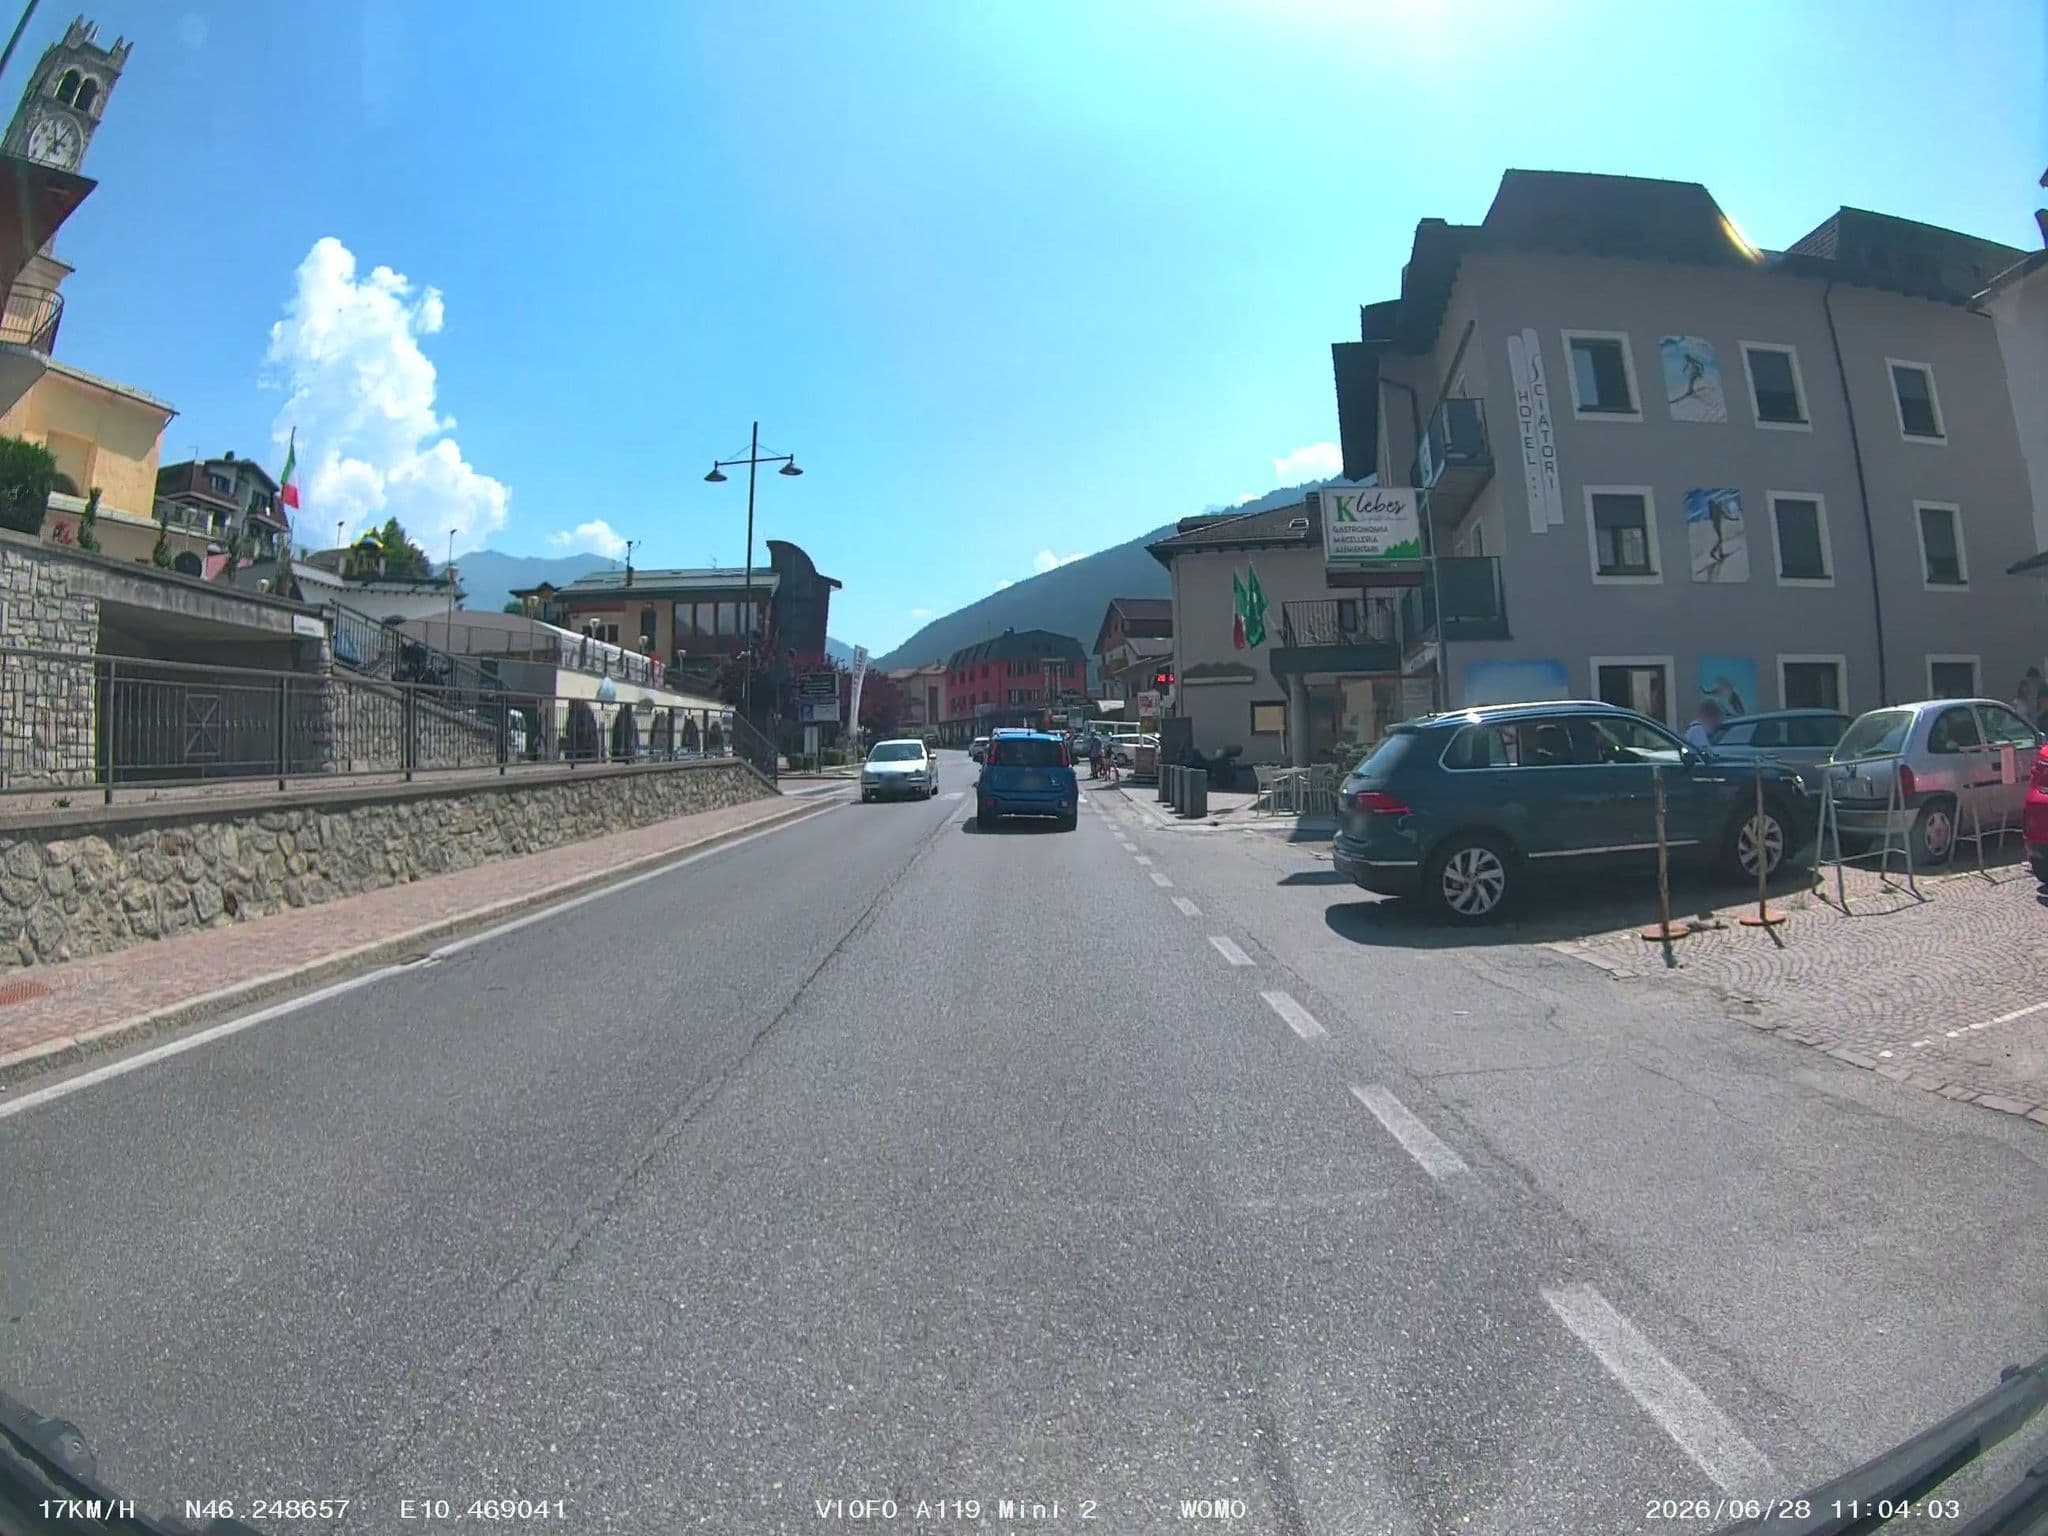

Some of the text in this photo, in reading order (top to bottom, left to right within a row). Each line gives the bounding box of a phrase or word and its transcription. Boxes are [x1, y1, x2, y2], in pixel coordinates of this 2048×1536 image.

[1518, 391, 1537, 465] HOTEL
[1529, 354, 1555, 490] SCIATORI
[1332, 525, 1388, 534] GASTRONOMIA
[1333, 535, 1379, 544] MACELLERIA
